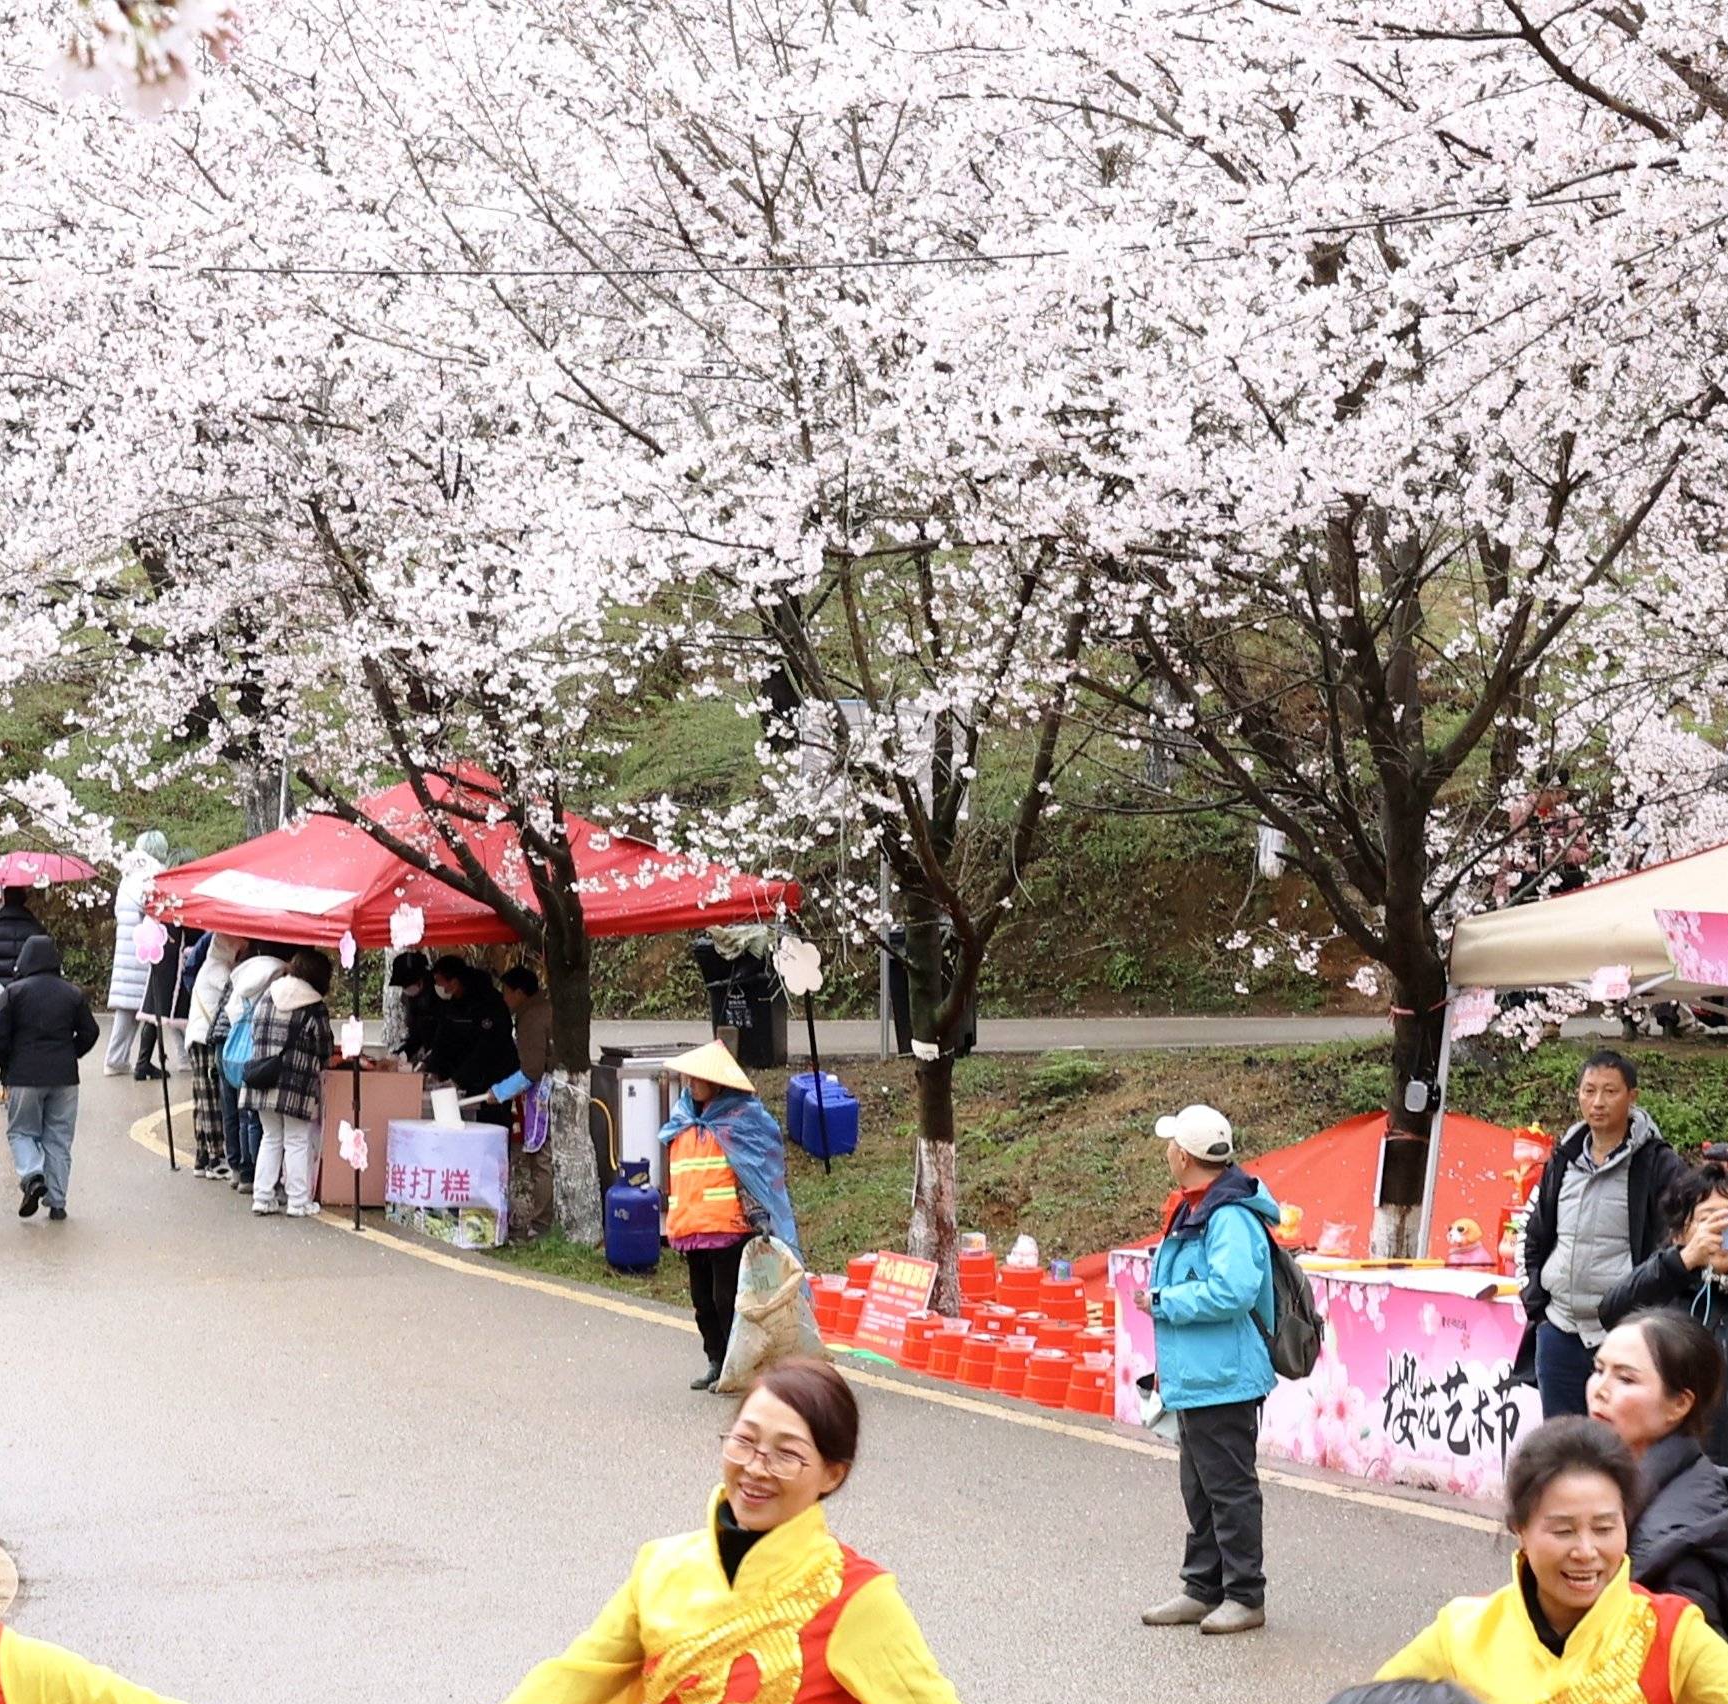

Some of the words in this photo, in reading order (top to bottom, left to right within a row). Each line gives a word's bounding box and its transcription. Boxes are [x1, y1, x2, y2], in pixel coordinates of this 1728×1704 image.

[1383, 1352, 1523, 1481] 樱花艺术节
